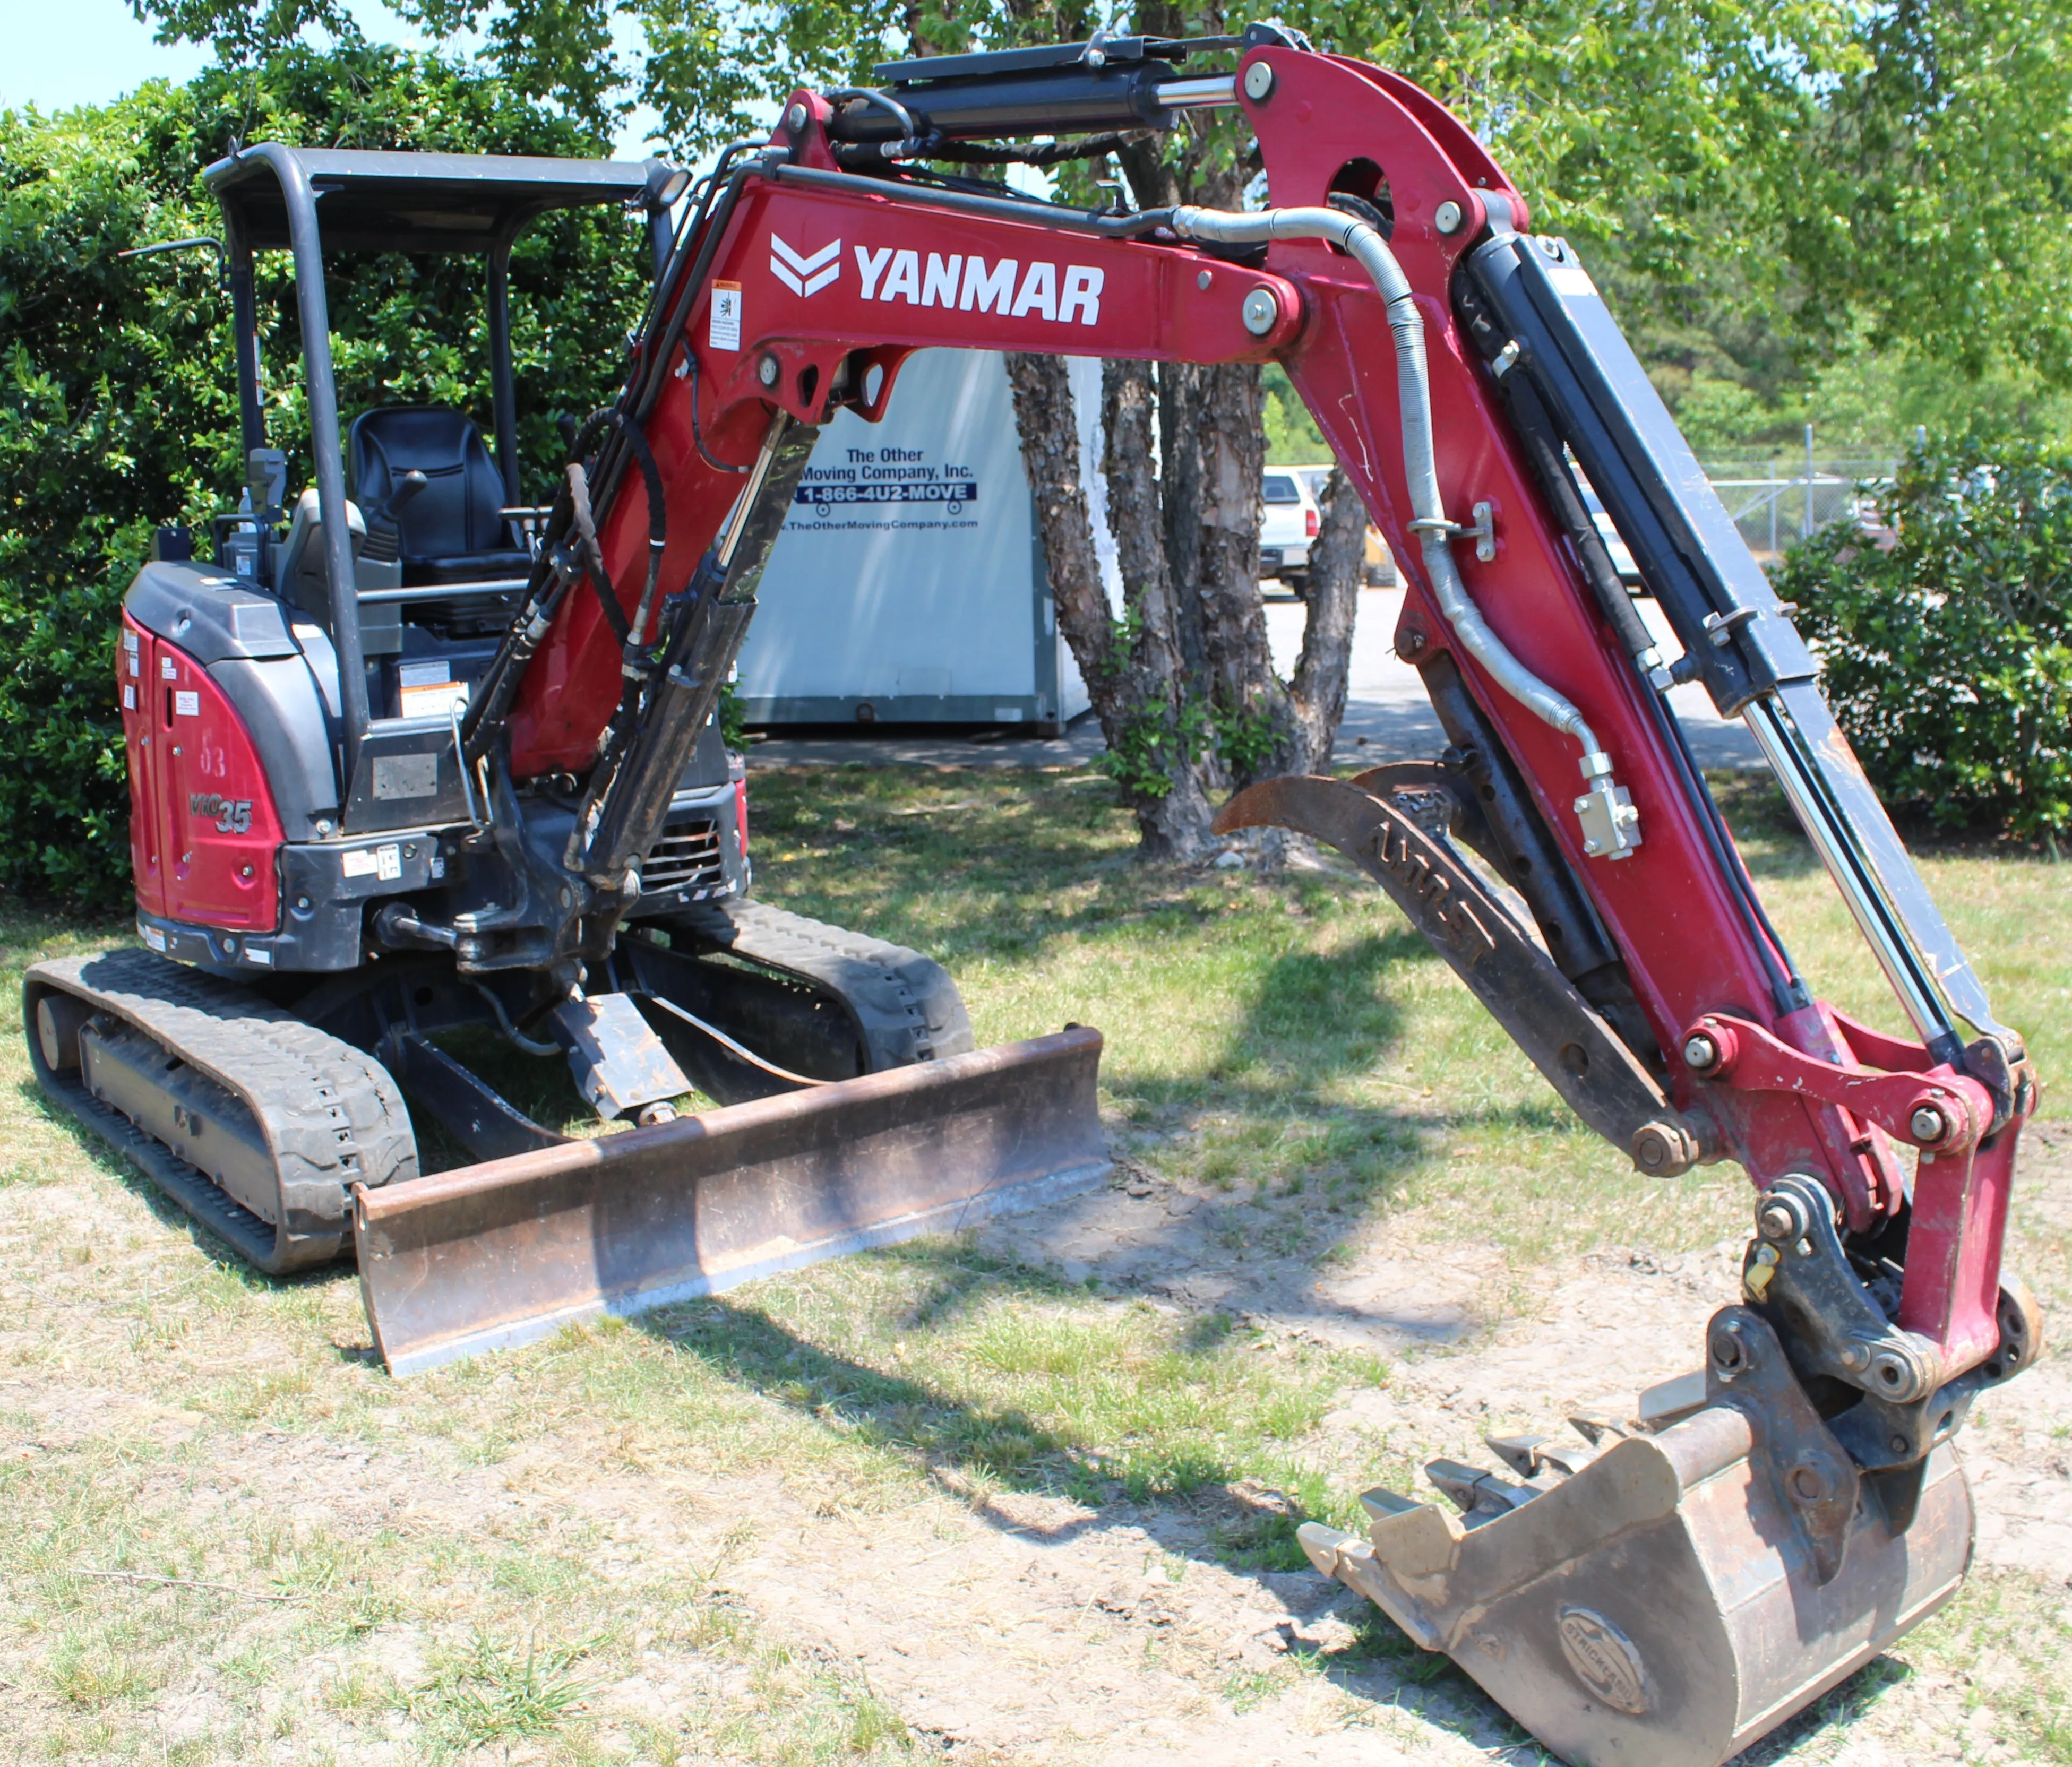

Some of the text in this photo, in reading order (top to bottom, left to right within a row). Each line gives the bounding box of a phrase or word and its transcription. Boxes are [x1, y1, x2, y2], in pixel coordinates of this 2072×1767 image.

[854, 245, 1105, 326] YANMAR
[846, 447, 924, 463] The Other
[802, 463, 974, 483] Moving Company, Inc.
[804, 484, 967, 502] 1-866-4U2-MOVE
